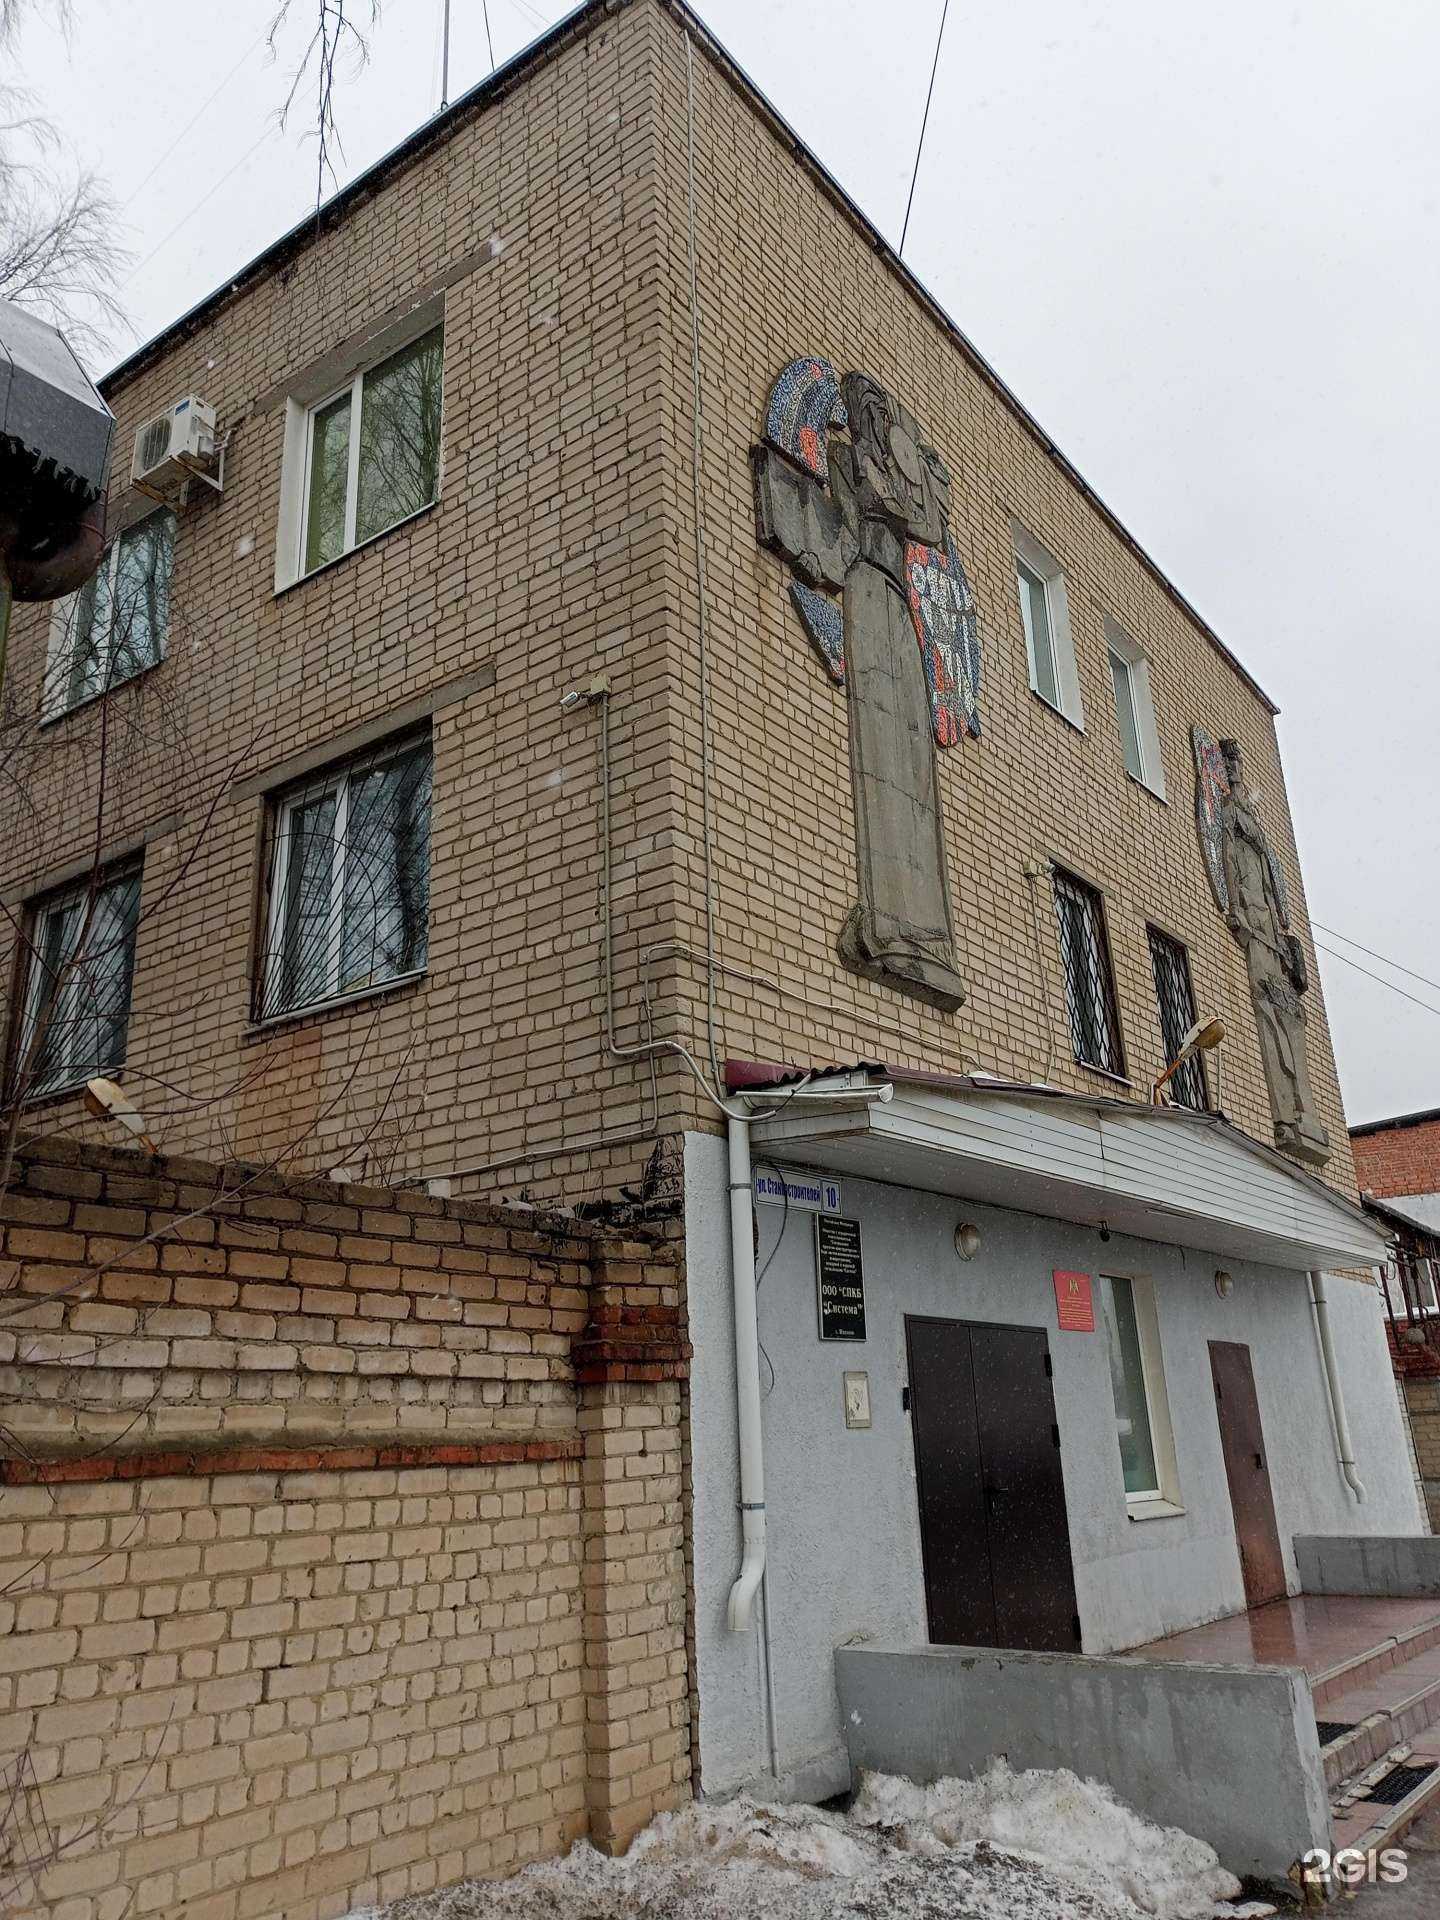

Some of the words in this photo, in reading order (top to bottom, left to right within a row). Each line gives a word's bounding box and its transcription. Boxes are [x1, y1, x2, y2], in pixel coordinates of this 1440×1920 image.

[767, 1177, 820, 1202] Станкстроителей
[826, 1186, 837, 1209] 10
[822, 1284, 837, 1296] ООО
